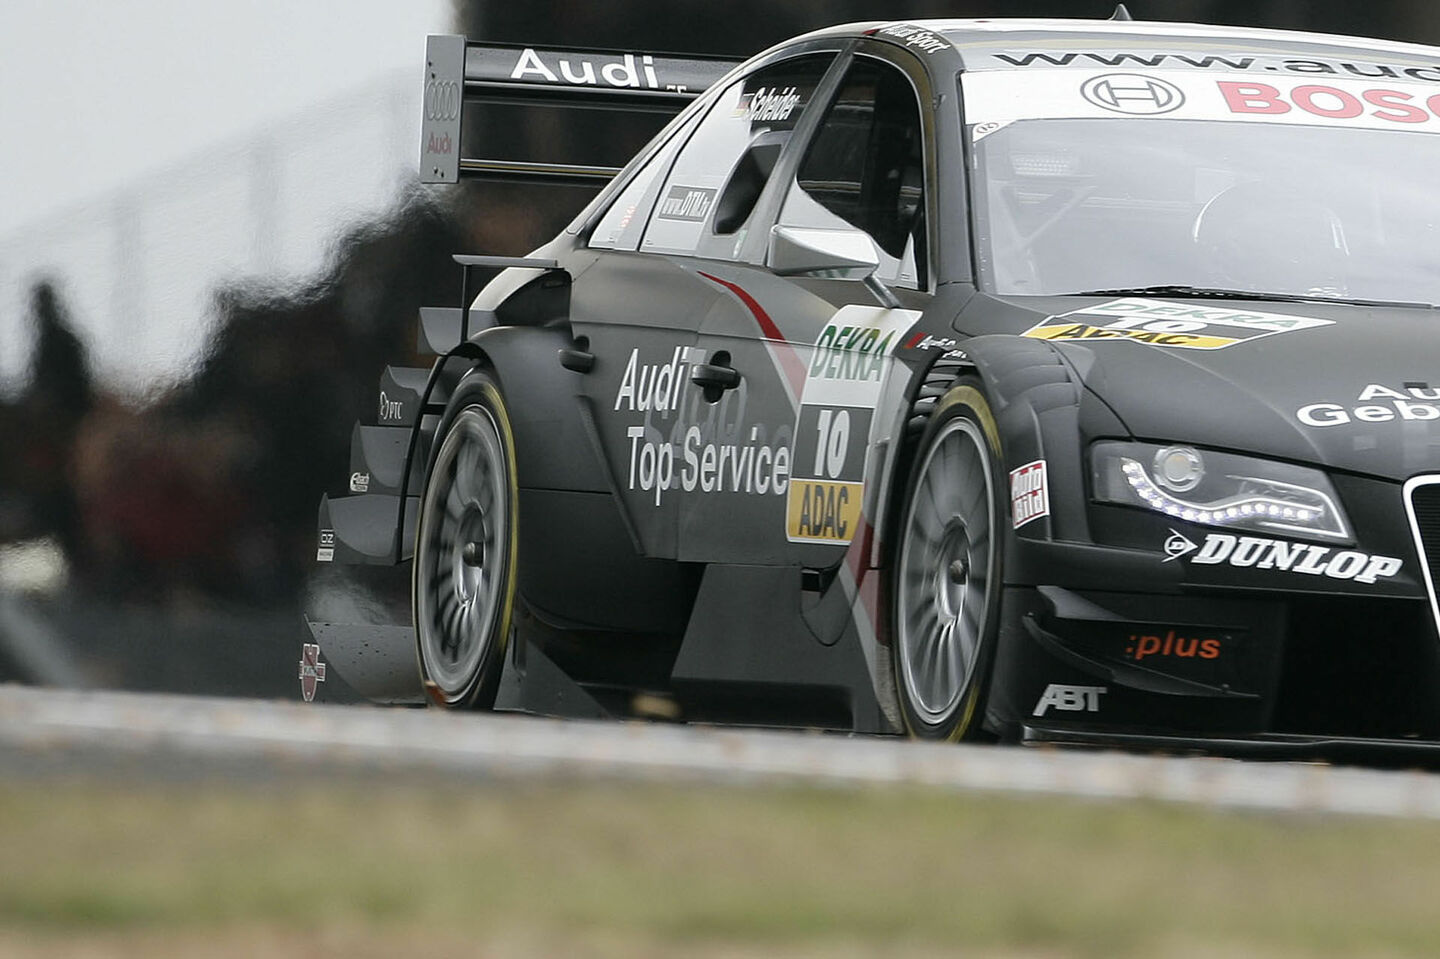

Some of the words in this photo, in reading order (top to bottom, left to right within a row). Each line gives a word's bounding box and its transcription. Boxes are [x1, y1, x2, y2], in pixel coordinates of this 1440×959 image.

[906, 31, 951, 54] Sport
[510, 48, 659, 88] Audi
[427, 132, 452, 155] Audi
[1099, 302, 1303, 330] DEKRA
[1103, 317, 1208, 333] 10
[809, 324, 896, 382] DEKRA
[614, 345, 690, 412] Audi
[627, 426, 674, 507] Top
[681, 426, 790, 496] Service
[813, 409, 850, 479] 10
[798, 485, 849, 540] ADAC
[1191, 533, 1402, 584] DUNLOP
[1033, 684, 1107, 716] ABT
